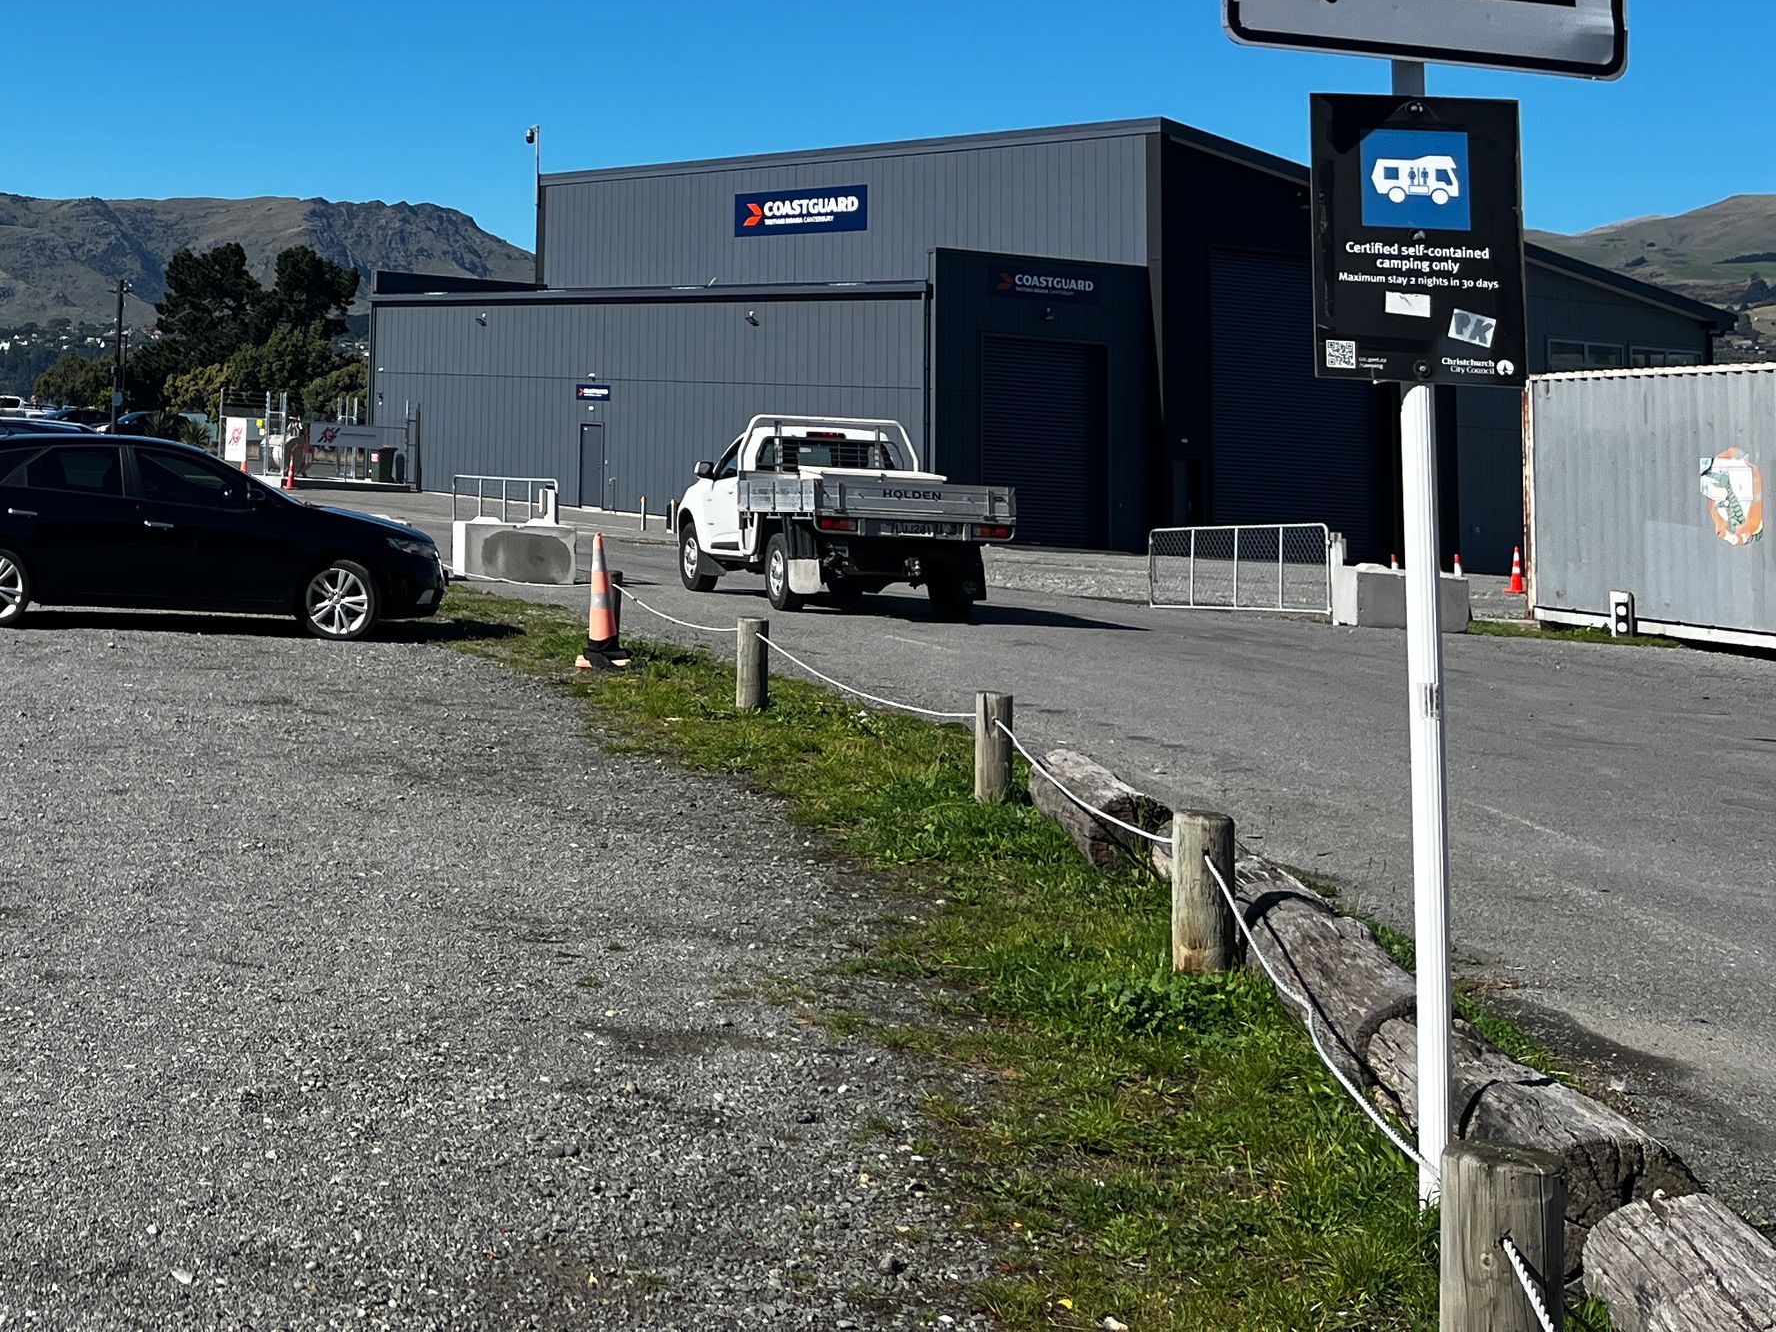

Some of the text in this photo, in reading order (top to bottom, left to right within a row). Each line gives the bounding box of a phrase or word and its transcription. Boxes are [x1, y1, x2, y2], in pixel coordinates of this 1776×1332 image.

[763, 196, 859, 216] COASTGUARD
[1345, 241, 1490, 259] Certified self-contained
[1376, 257, 1460, 274] camping only
[1015, 274, 1094, 291] COASTGUARD
[1338, 272, 1499, 290] Maximum stay 2 nights in 30 days
[1441, 357, 1495, 367] Christchurch
[1450, 365, 1495, 375] City Council
[883, 489, 942, 500] HOLDEN
